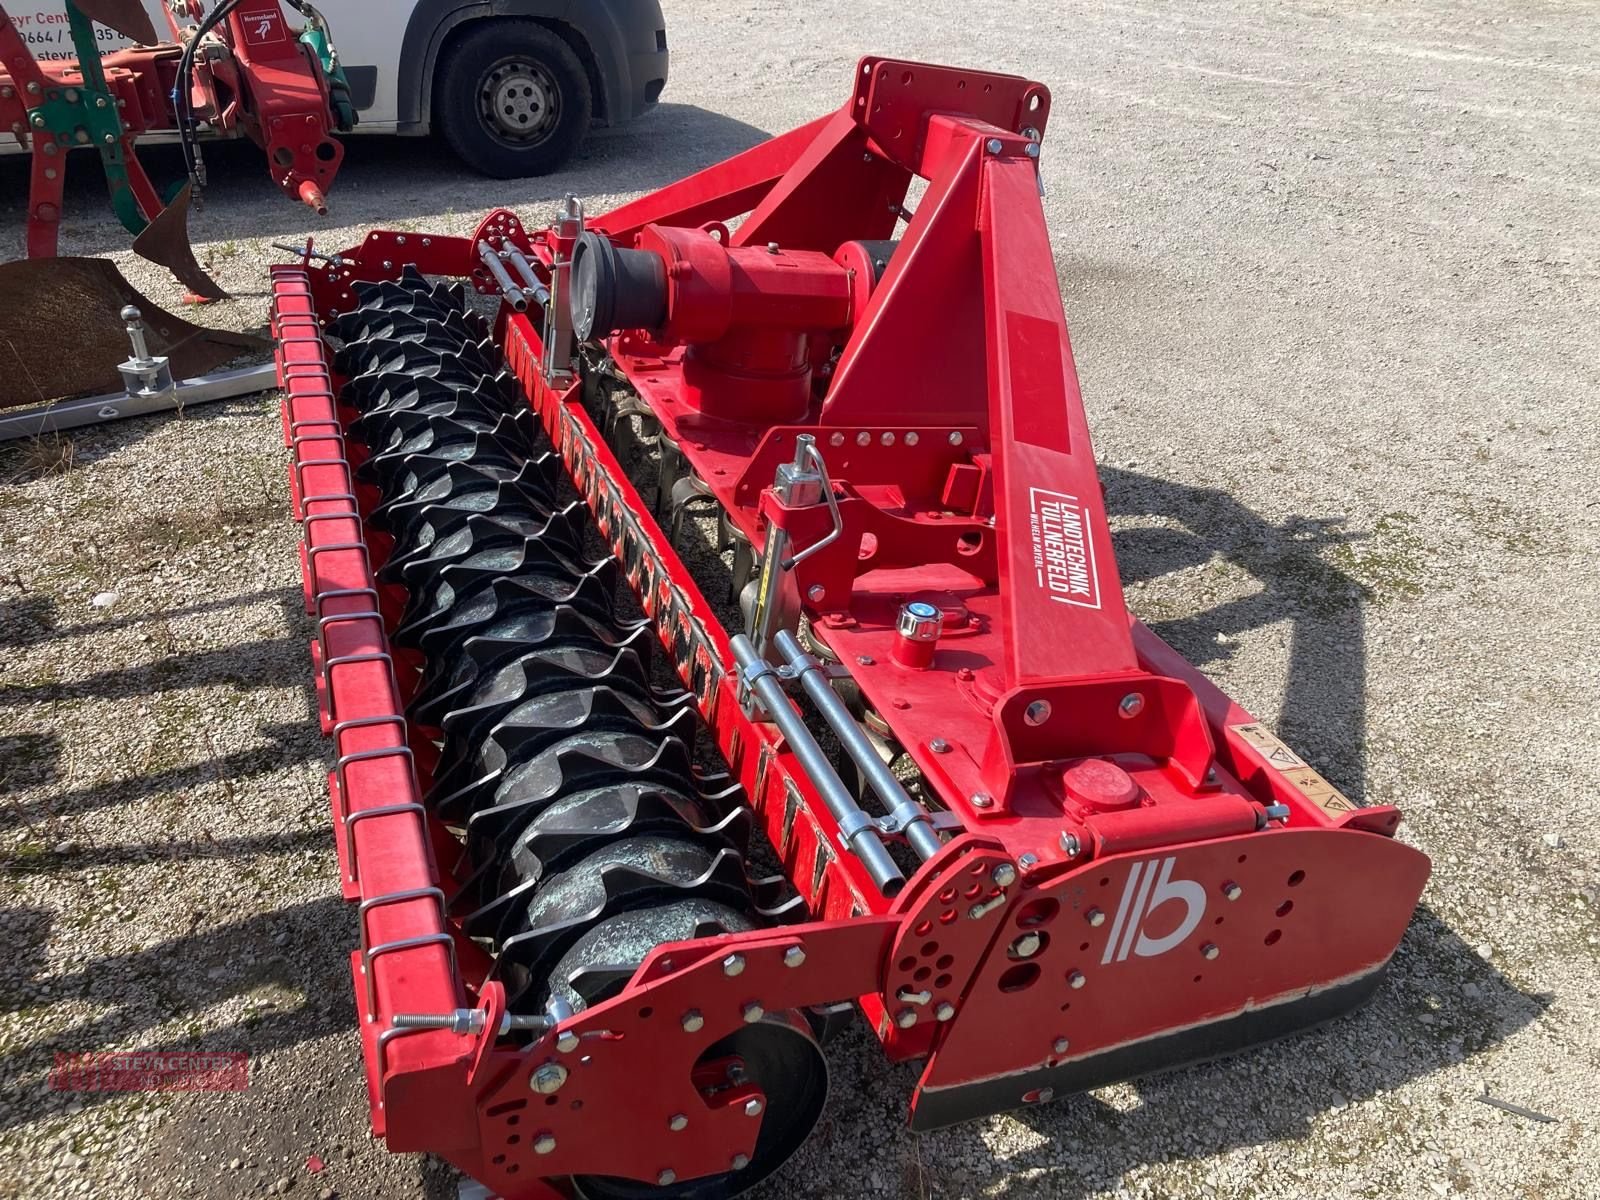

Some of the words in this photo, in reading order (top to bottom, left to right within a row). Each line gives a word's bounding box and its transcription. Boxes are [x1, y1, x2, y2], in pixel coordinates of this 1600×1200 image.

[9, 15, 31, 28] eyr
[36, 11, 70, 24] Cent
[96, 28, 113, 40] 35
[1030, 513, 1041, 542] WILHELM
[1040, 500, 1069, 593] TULLNERFELD
[1060, 502, 1091, 598] LANDTECHNIK
